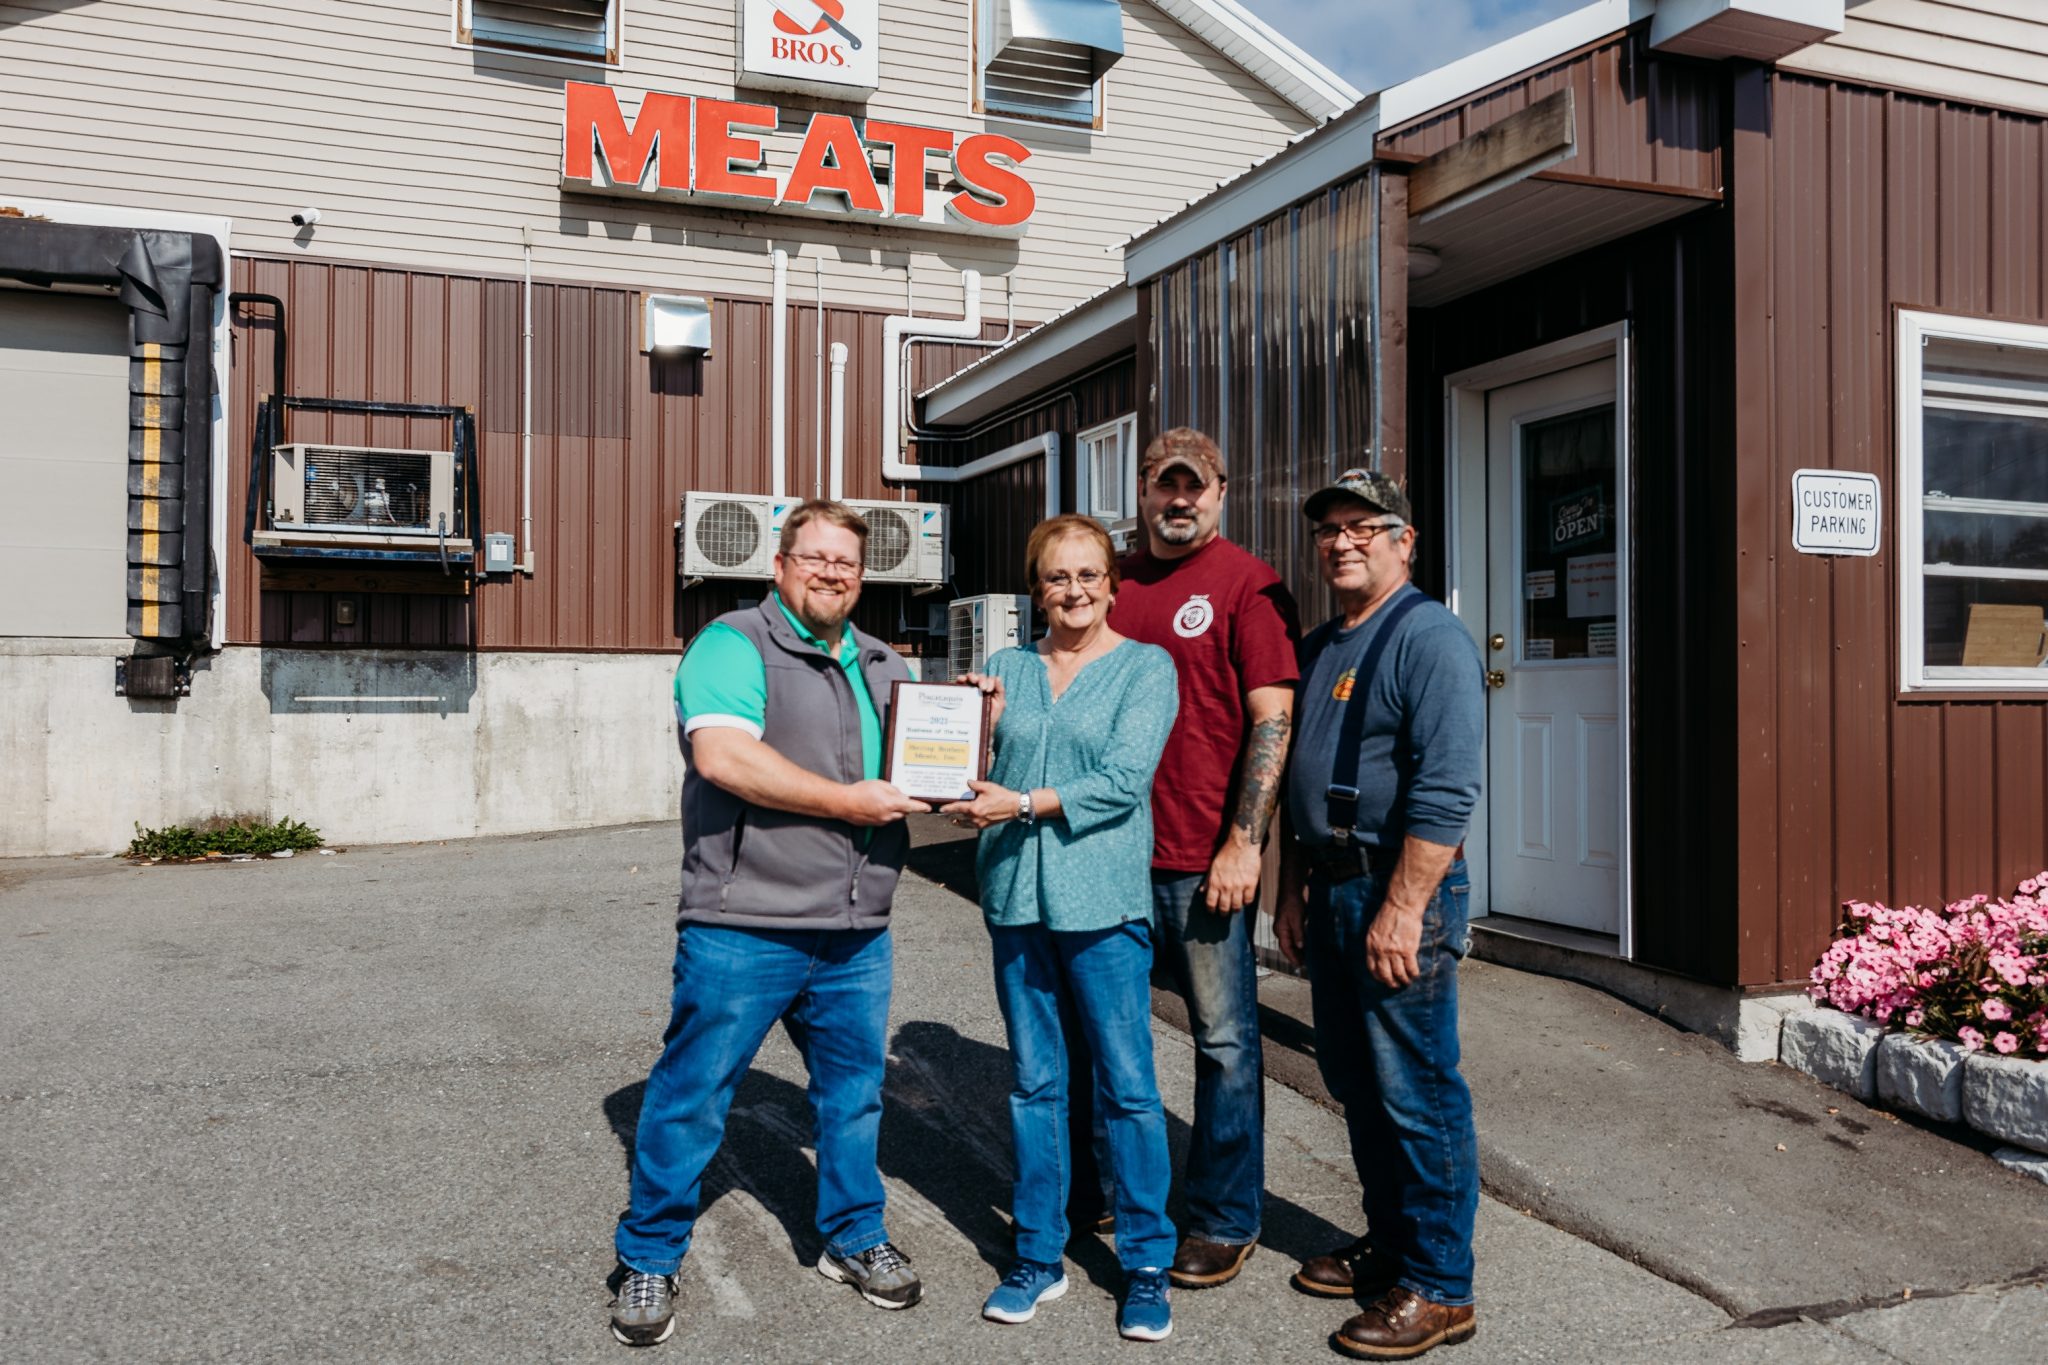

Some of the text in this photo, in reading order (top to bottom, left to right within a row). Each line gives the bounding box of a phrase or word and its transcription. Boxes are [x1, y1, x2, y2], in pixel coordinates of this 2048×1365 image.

[771, 37, 851, 68] BROS.
[563, 80, 1037, 227] MEATS
[1803, 490, 1872, 511] CUSTOMER
[1555, 513, 1598, 542] OPEN
[1811, 515, 1866, 535] PARKING
